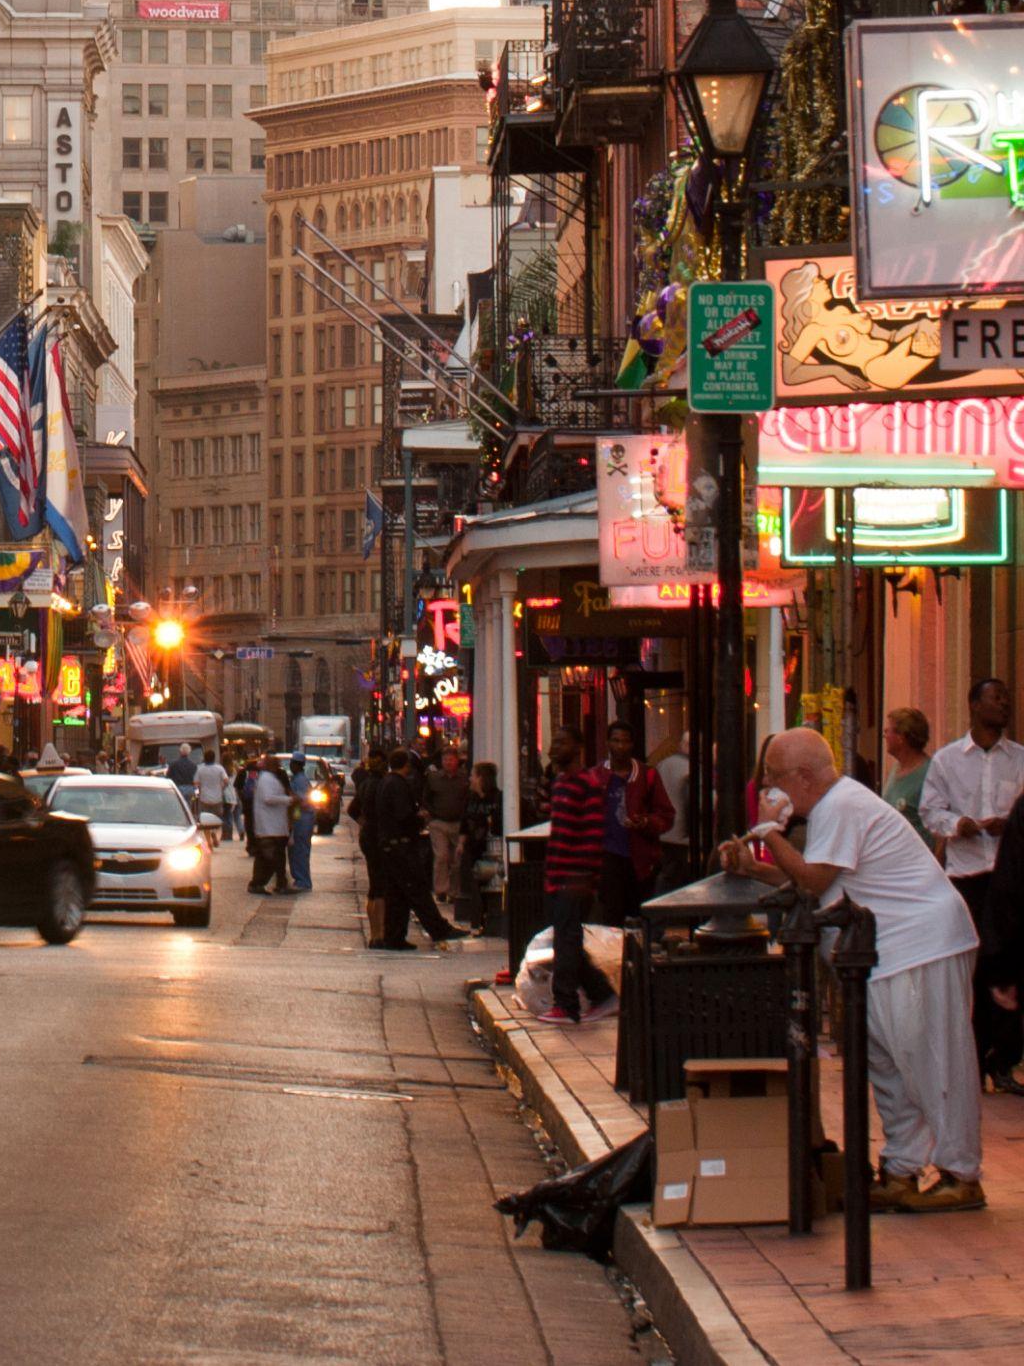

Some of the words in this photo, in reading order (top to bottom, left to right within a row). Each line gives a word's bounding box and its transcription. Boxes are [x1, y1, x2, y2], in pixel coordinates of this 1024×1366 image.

[148, 4, 219, 19] woodward
[698, 295, 713, 305] NO
[717, 294, 765, 306] BOTTLES
[704, 307, 718, 318] OR
[714, 361, 733, 371] MAY
[737, 361, 748, 371] BE
[706, 372, 716, 381] IN
[719, 371, 756, 381] PLASTIC
[703, 382, 760, 392] CONTAINERS
